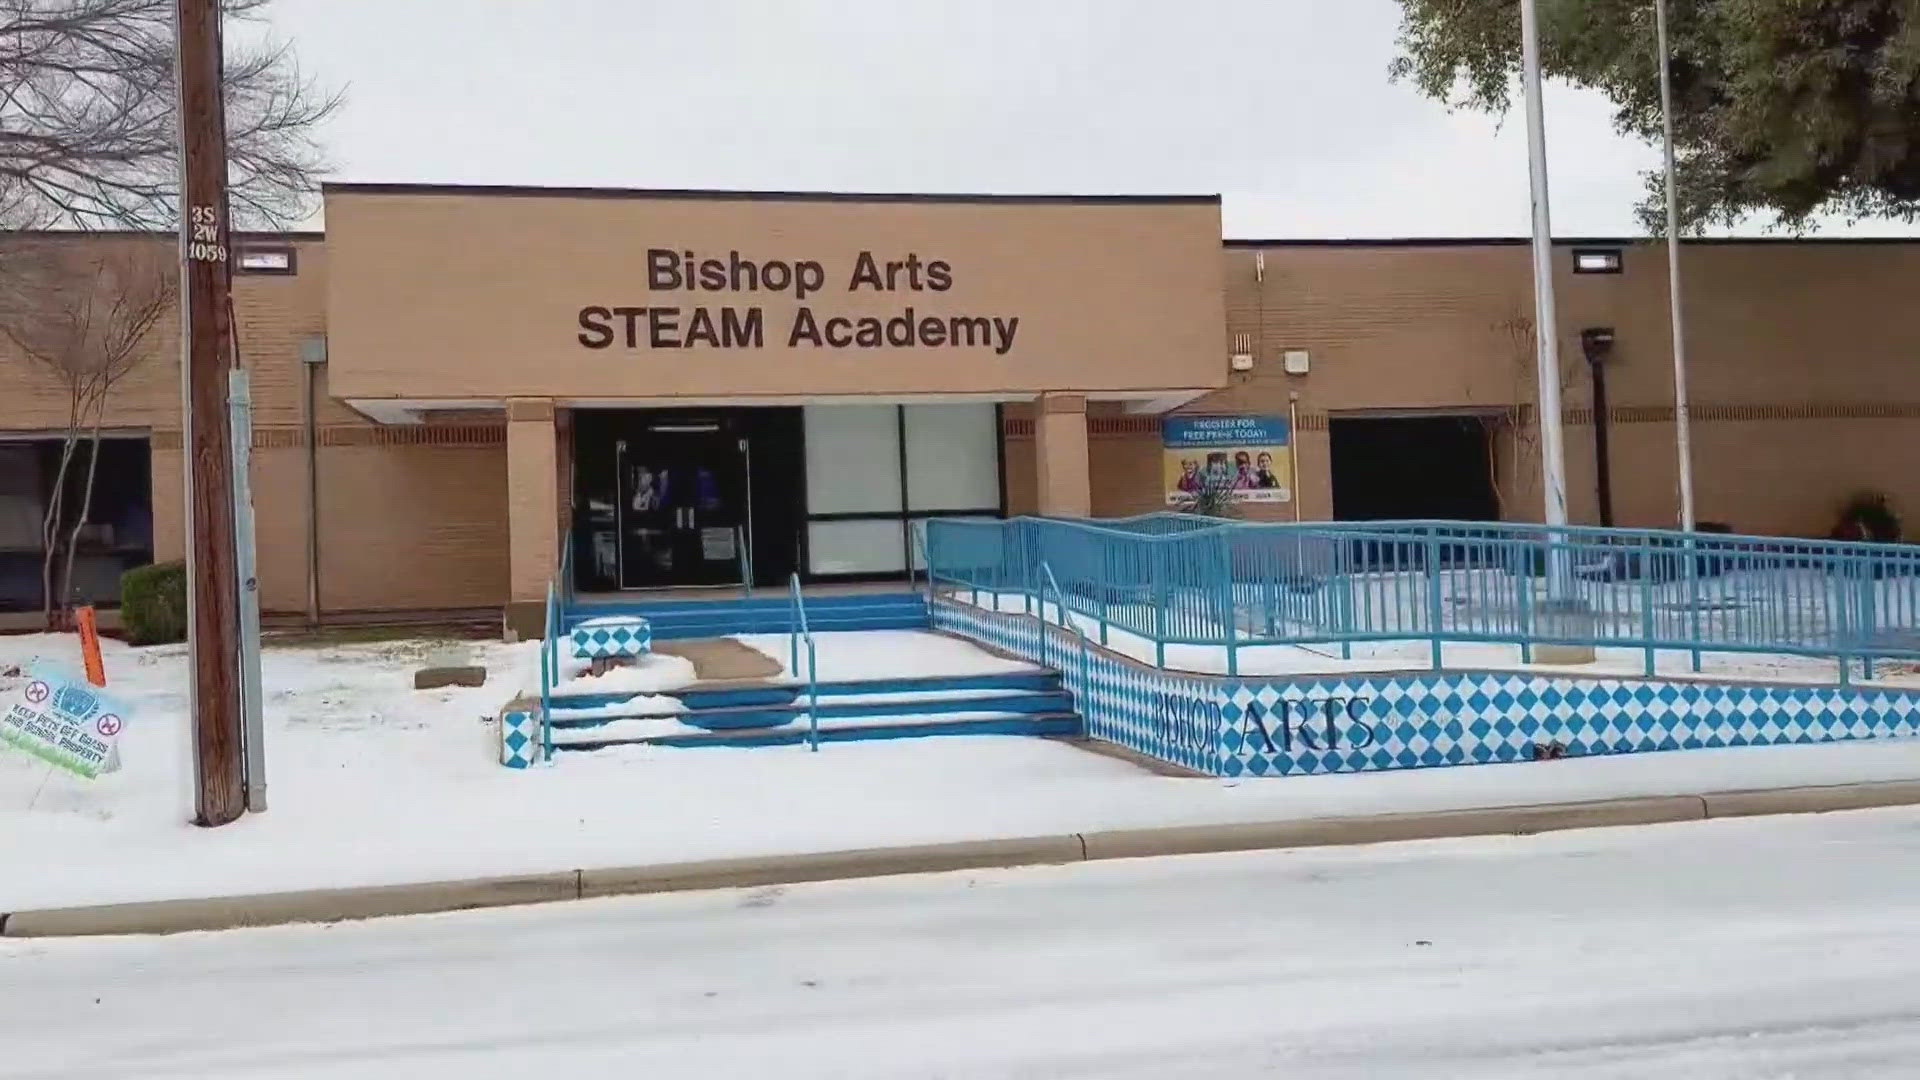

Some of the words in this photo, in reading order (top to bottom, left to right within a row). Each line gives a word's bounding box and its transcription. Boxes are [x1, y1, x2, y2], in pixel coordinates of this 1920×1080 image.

[192, 206, 215, 223] 3S
[194, 223, 218, 242] 2W
[189, 242, 227, 262] 1059
[647, 249, 825, 300] Bishop
[848, 251, 953, 292] Arts
[577, 306, 764, 348] STEAM
[787, 306, 1019, 355] Academy
[1235, 430, 1267, 439] TODAY!
[1237, 419, 1257, 428] FOR
[13, 704, 37, 719] KEEP
[36, 713, 60, 731] PETS
[60, 725, 79, 739] OFF
[79, 733, 109, 753] GRASS
[1154, 691, 1222, 755] BISHOP
[1237, 697, 1375, 756] ARTS
[59, 737, 105, 764] PROPERTY
